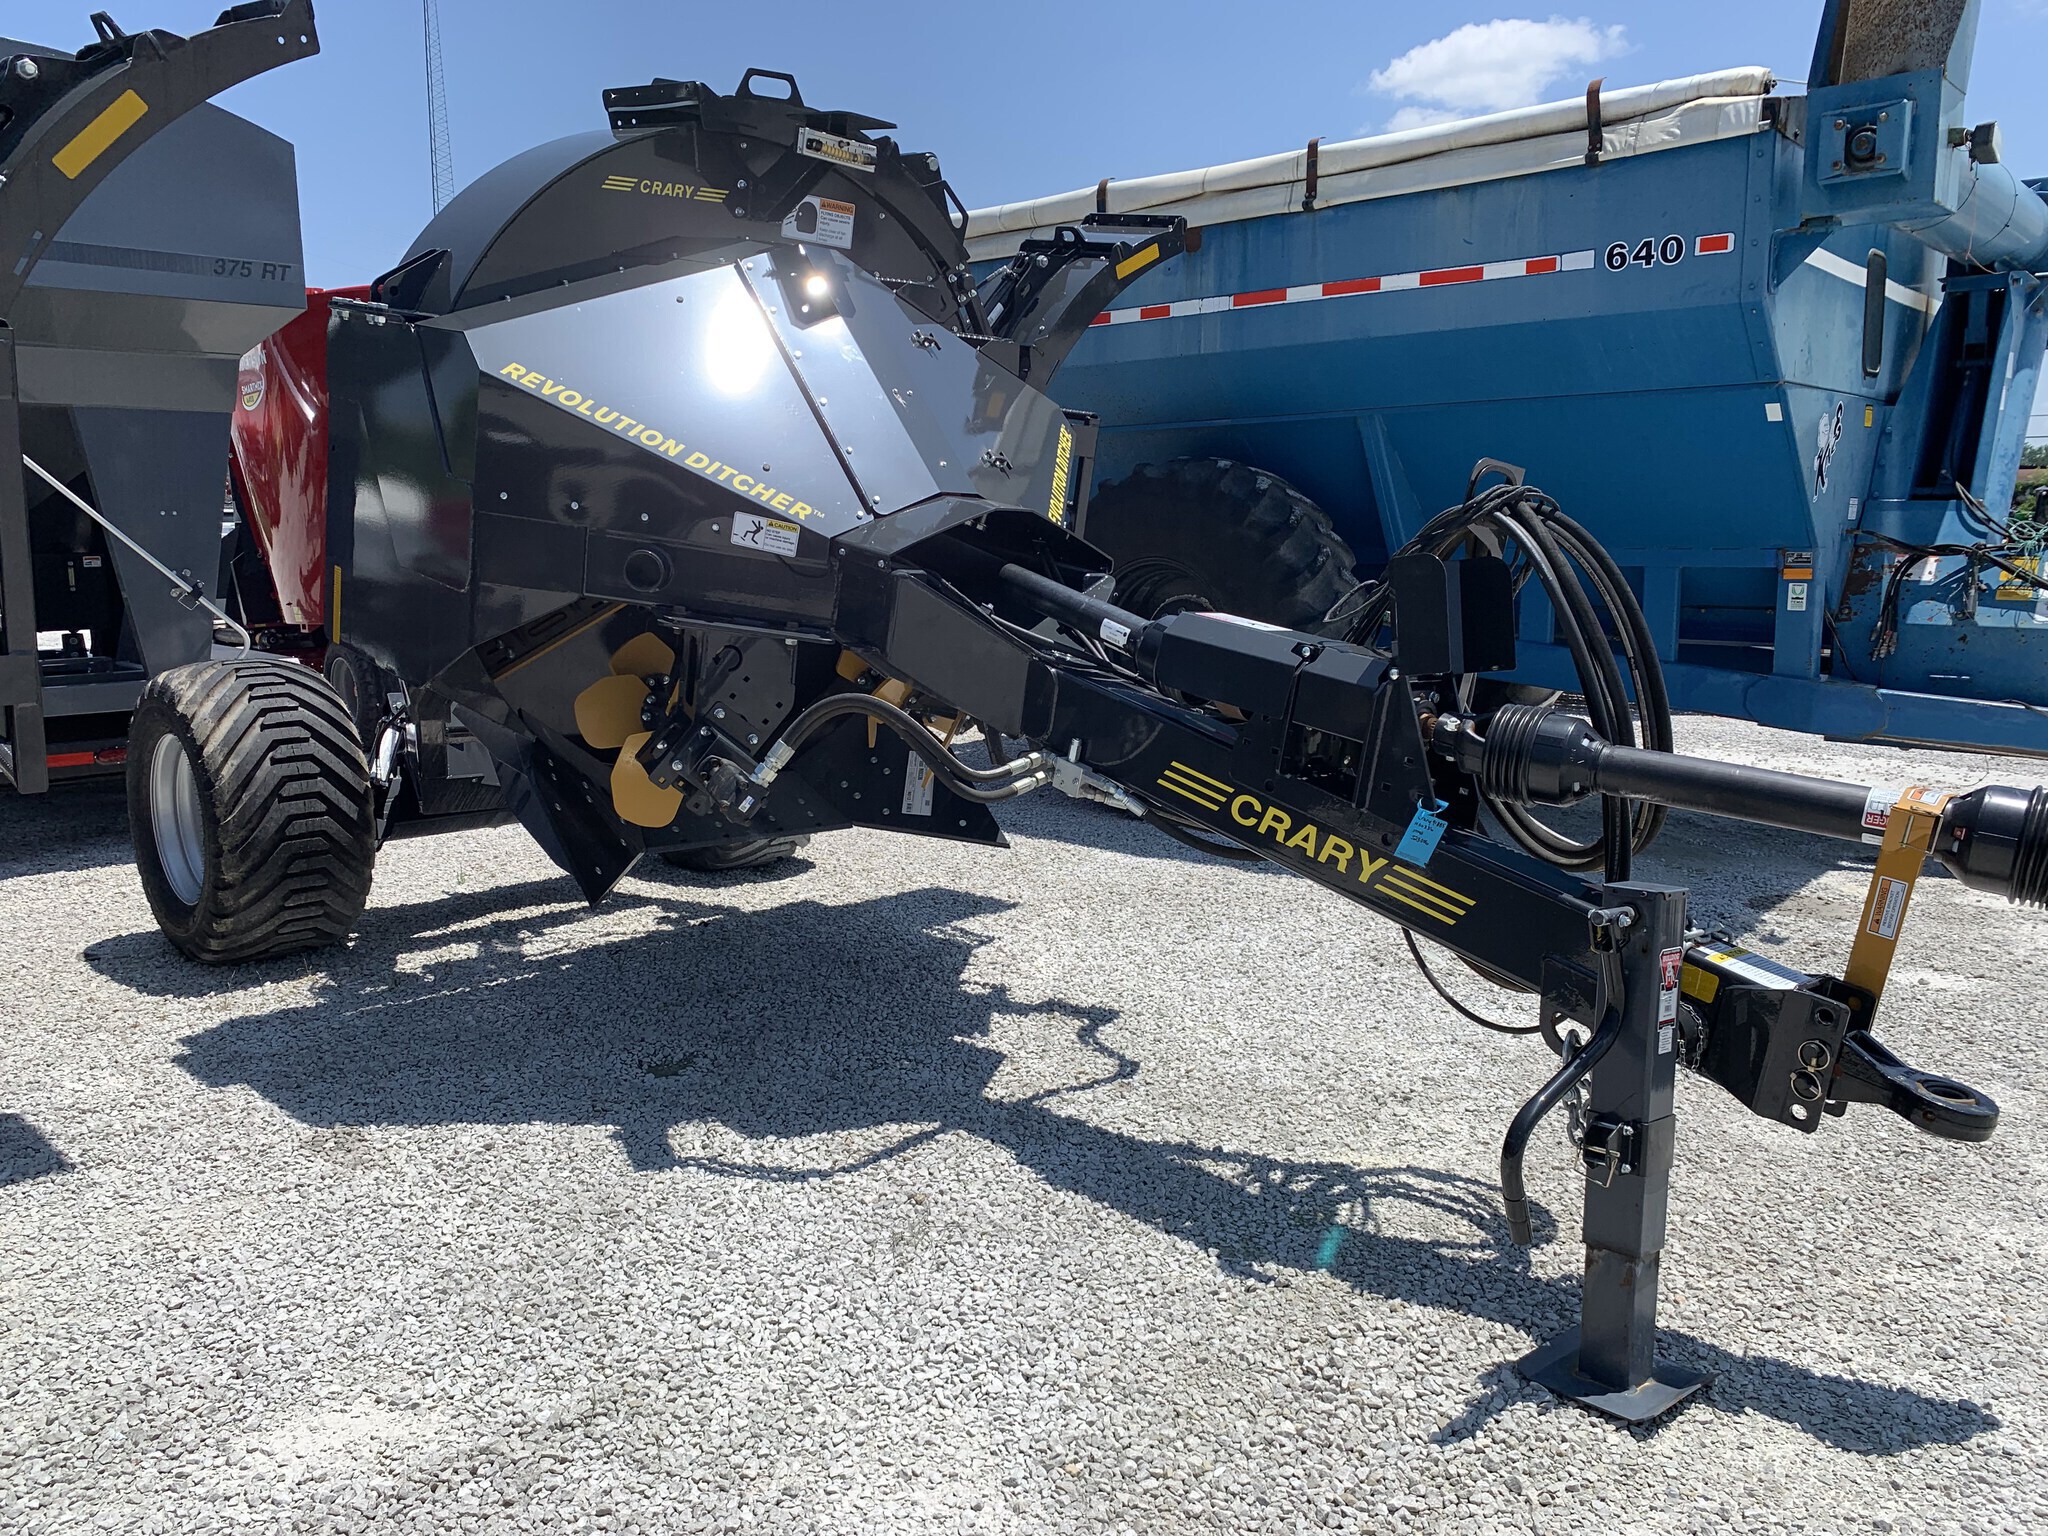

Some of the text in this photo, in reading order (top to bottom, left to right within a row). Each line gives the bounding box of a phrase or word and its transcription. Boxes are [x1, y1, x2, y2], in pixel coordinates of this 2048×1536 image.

[640, 179, 695, 199] CRARY
[826, 202, 854, 214] WARNING
[1605, 234, 1685, 272] 640
[213, 258, 291, 282] 375 RT
[500, 362, 686, 457] REVOLUTION
[774, 522, 797, 532] CAUTION
[1866, 813, 1887, 829] GER
[1231, 794, 1389, 883] CRARY
[1875, 887, 1888, 916] WARNING
[1882, 890, 1895, 927] REMOVE BRACKET
[1891, 891, 1901, 913] OPERATION
